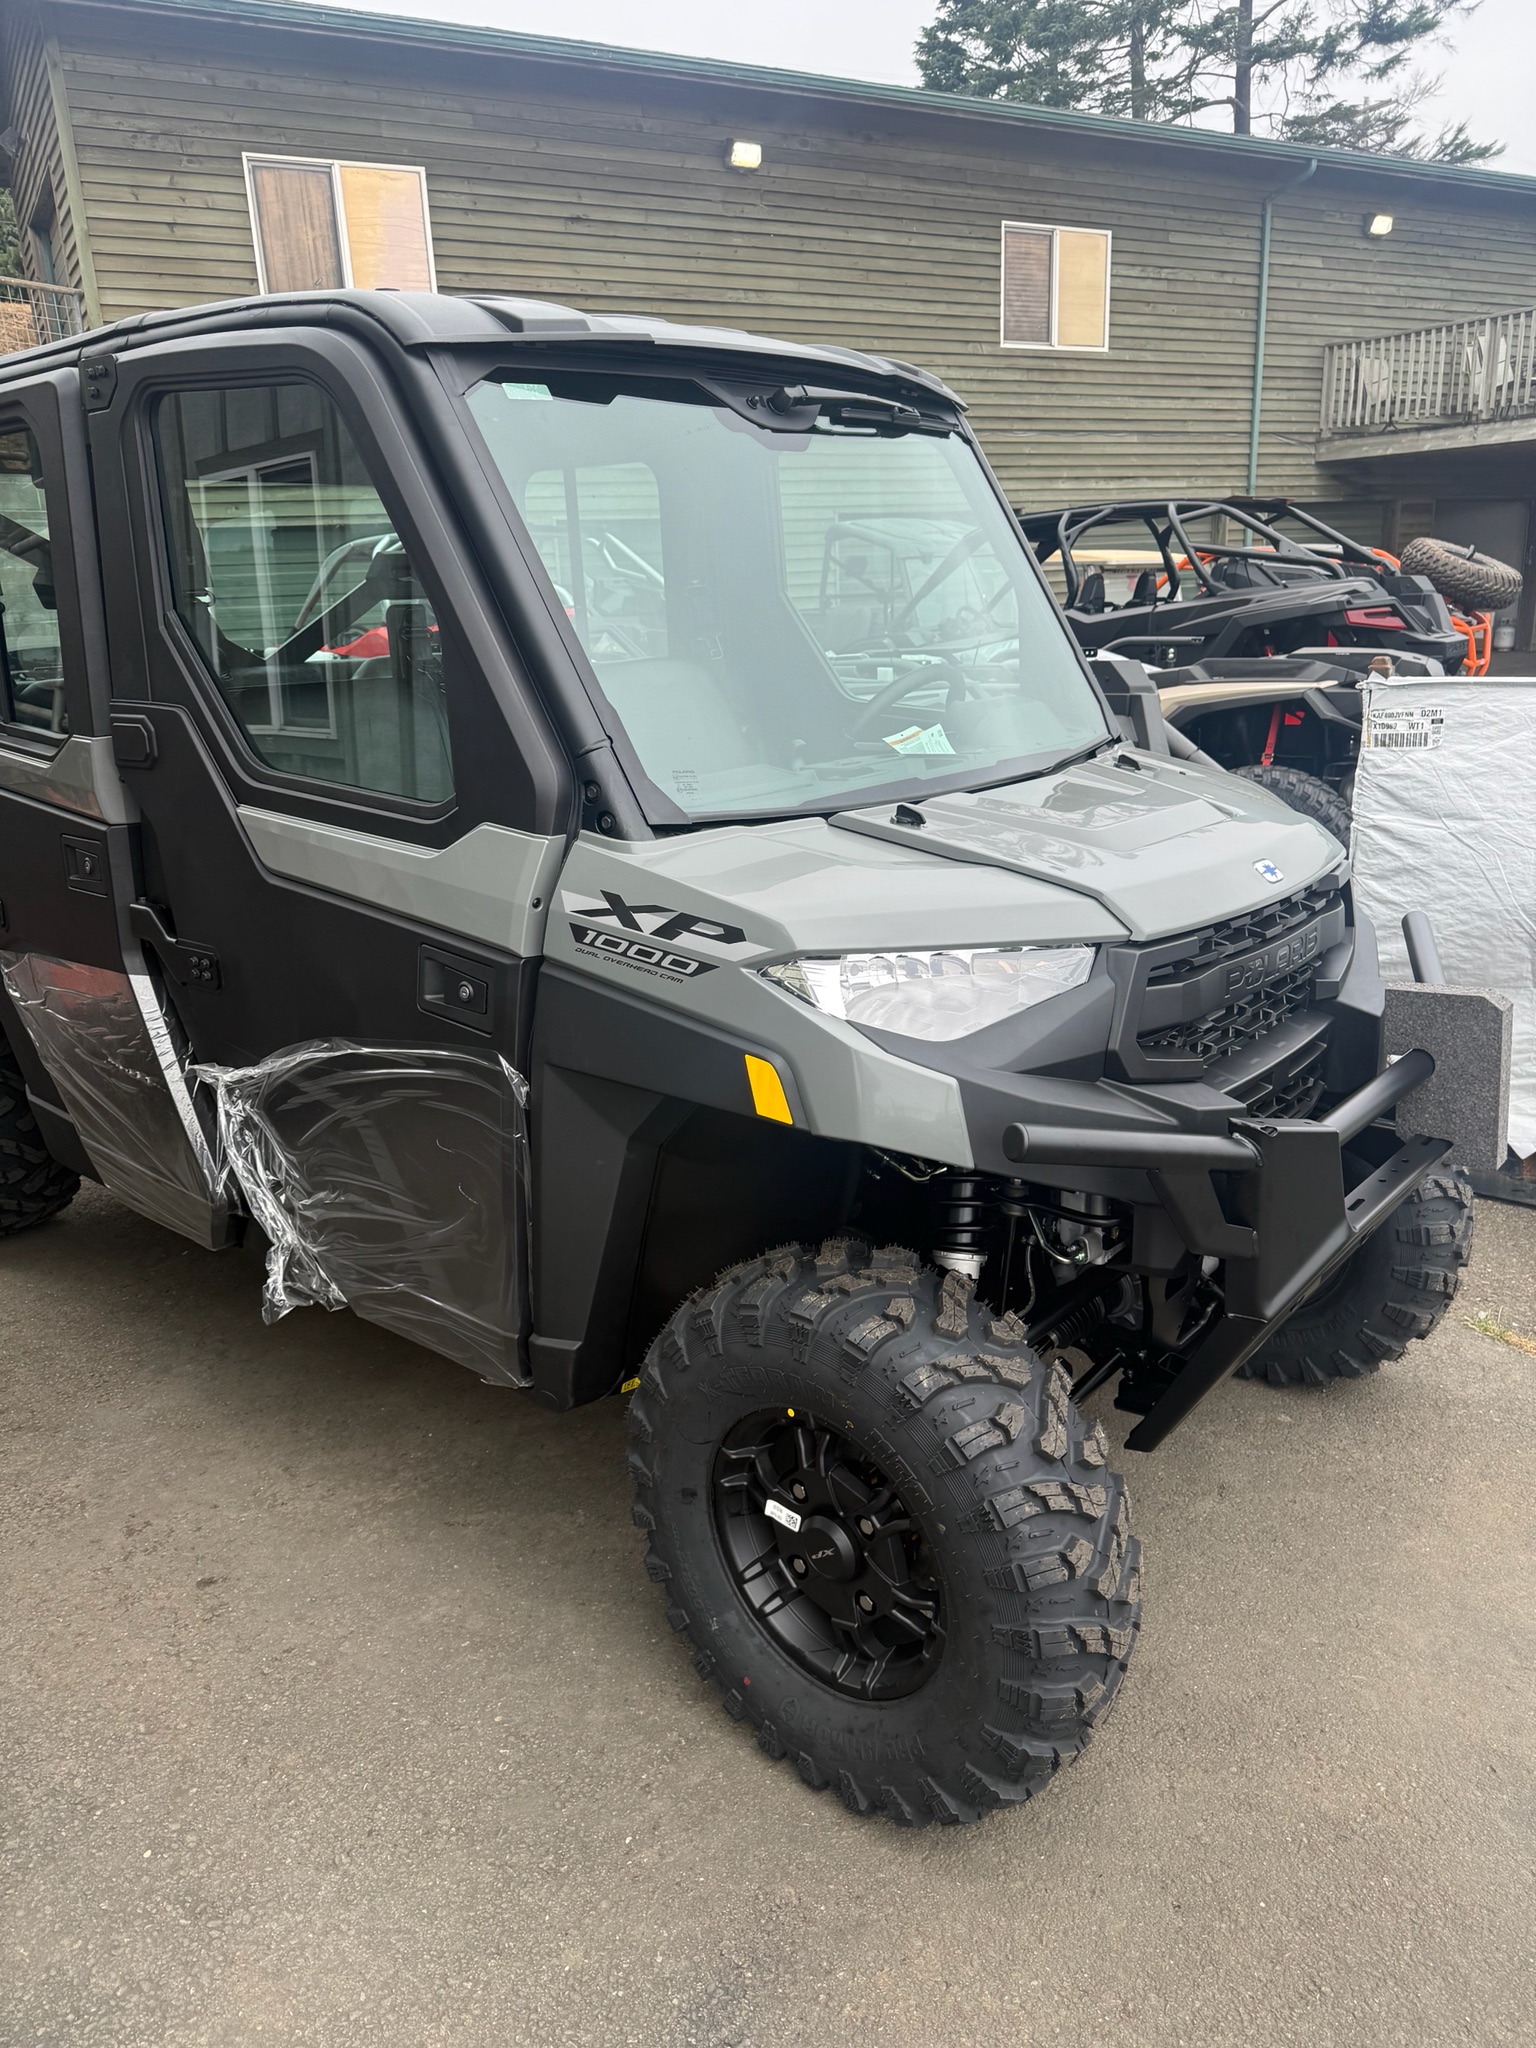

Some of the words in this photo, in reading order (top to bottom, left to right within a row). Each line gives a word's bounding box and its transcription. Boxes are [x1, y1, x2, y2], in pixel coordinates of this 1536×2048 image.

[1408, 722, 1425, 730] WT1
[1421, 709, 1443, 718] D2M1
[569, 889, 747, 945] XP
[574, 946, 601, 959] DUAL
[602, 955, 659, 976] OVERHEAD
[659, 973, 684, 984] CAM
[582, 929, 700, 975] 1000
[1224, 925, 1318, 999] POLARIS
[811, 1547, 836, 1561] XP
